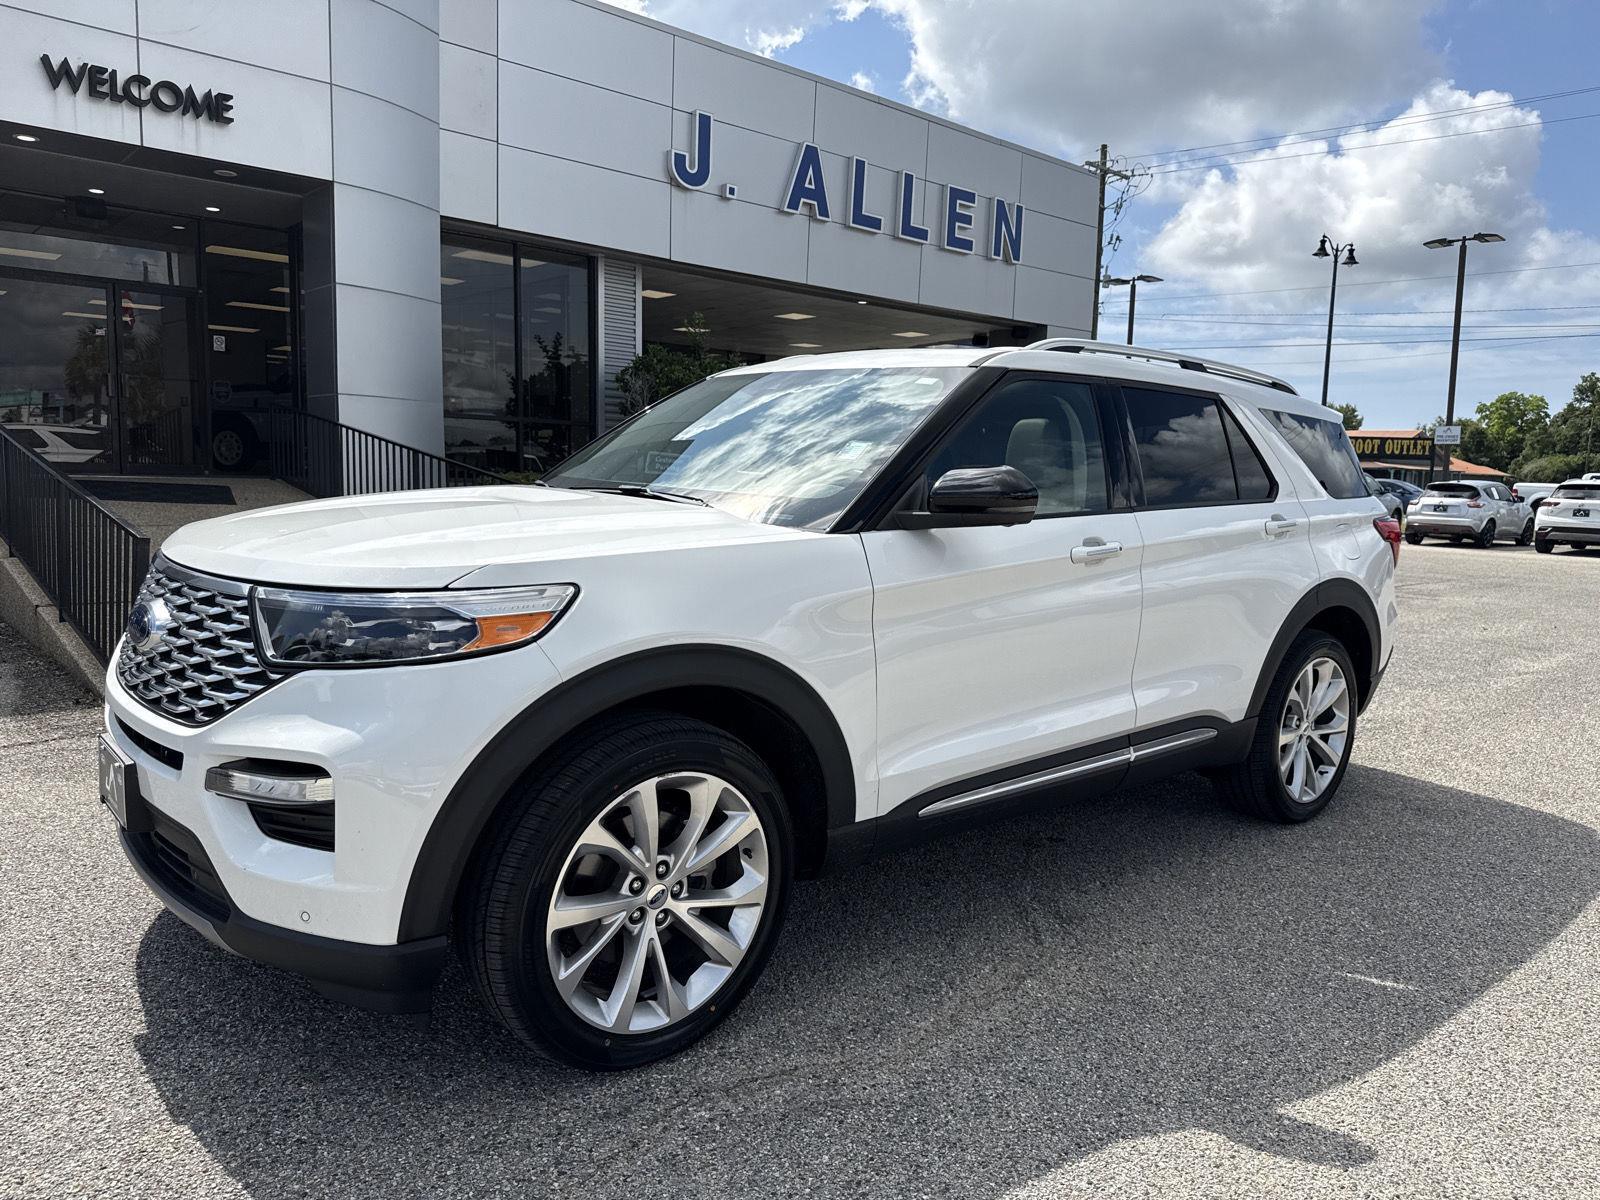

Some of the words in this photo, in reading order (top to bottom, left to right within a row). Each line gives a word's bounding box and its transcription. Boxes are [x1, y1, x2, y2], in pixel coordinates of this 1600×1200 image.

[40, 54, 234, 125] WELCOME
[667, 109, 737, 200] J.
[780, 141, 1025, 264] ALLEN
[1385, 439, 1432, 455] OUTLET
